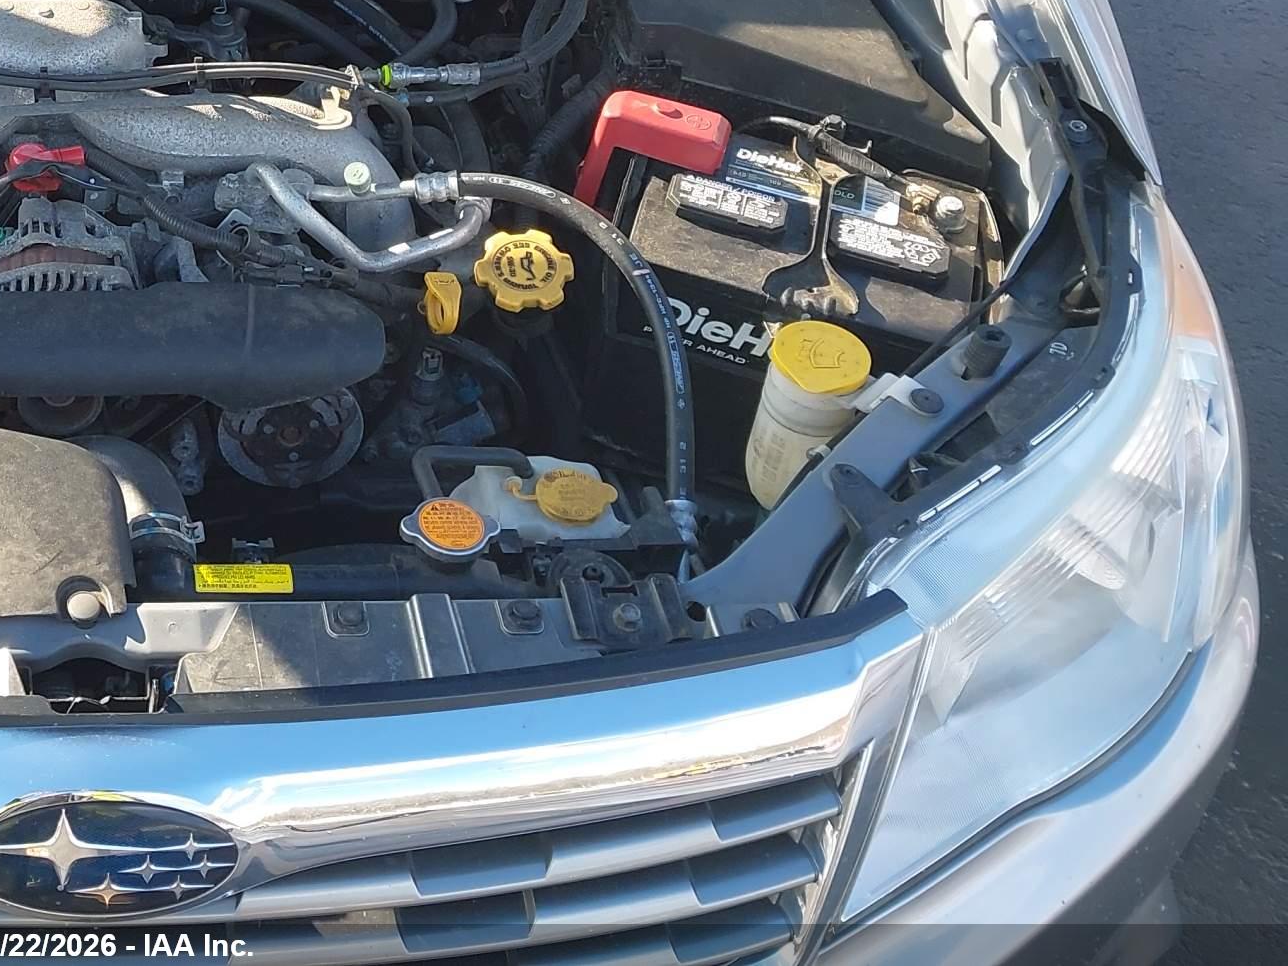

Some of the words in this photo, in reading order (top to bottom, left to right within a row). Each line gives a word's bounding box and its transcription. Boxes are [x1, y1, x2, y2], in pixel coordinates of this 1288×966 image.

[736, 148, 804, 173] DieHar
[697, 175, 733, 191] DANGER
[740, 188, 775, 202] POISON
[834, 190, 855, 199] OLD
[503, 277, 539, 290] MANUAL
[539, 272, 553, 282] OIL
[667, 296, 772, 357] DieH
[696, 344, 746, 365] AHEAD
